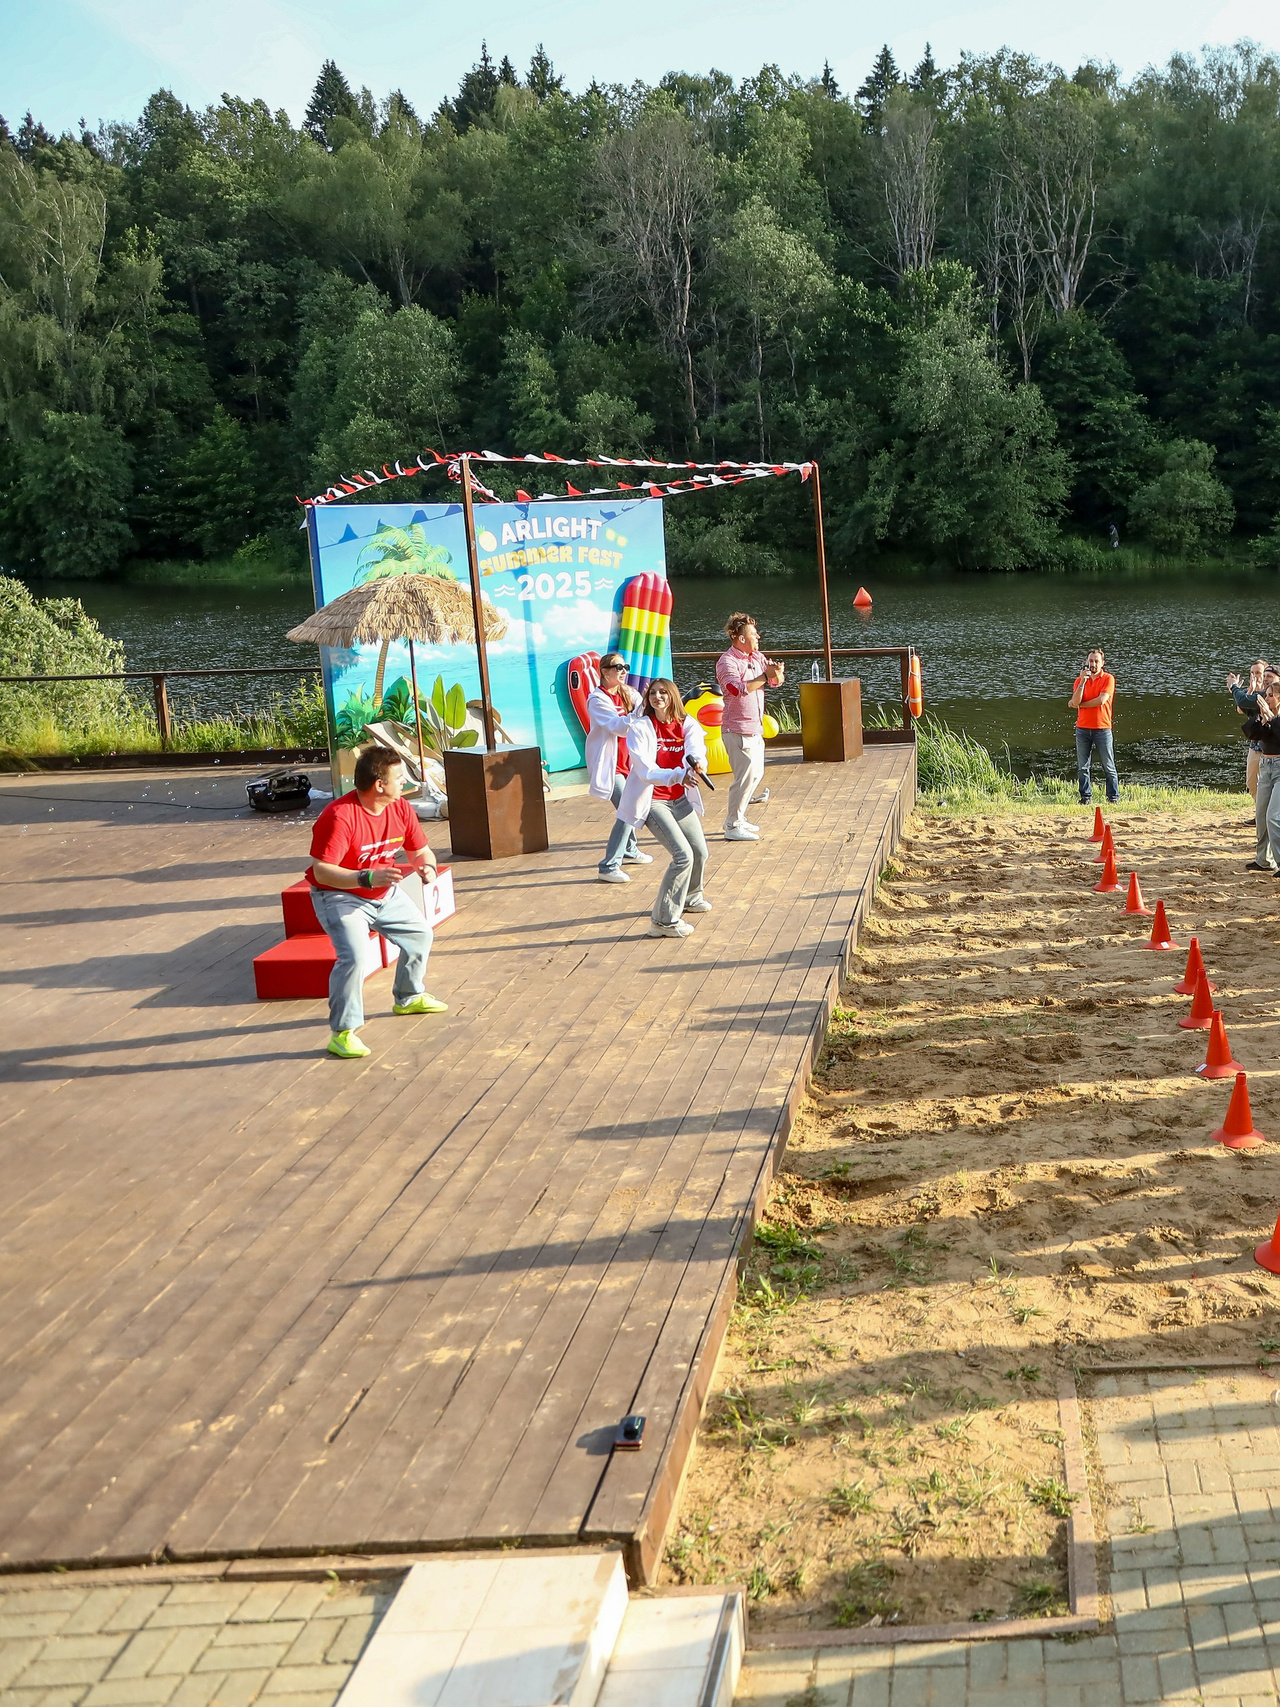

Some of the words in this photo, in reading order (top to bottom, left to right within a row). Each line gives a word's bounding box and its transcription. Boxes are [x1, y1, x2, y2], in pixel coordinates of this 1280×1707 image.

[502, 516, 603, 546] ARLIGHT
[517, 570, 592, 601] 2025
[433, 885, 441, 916] 2
